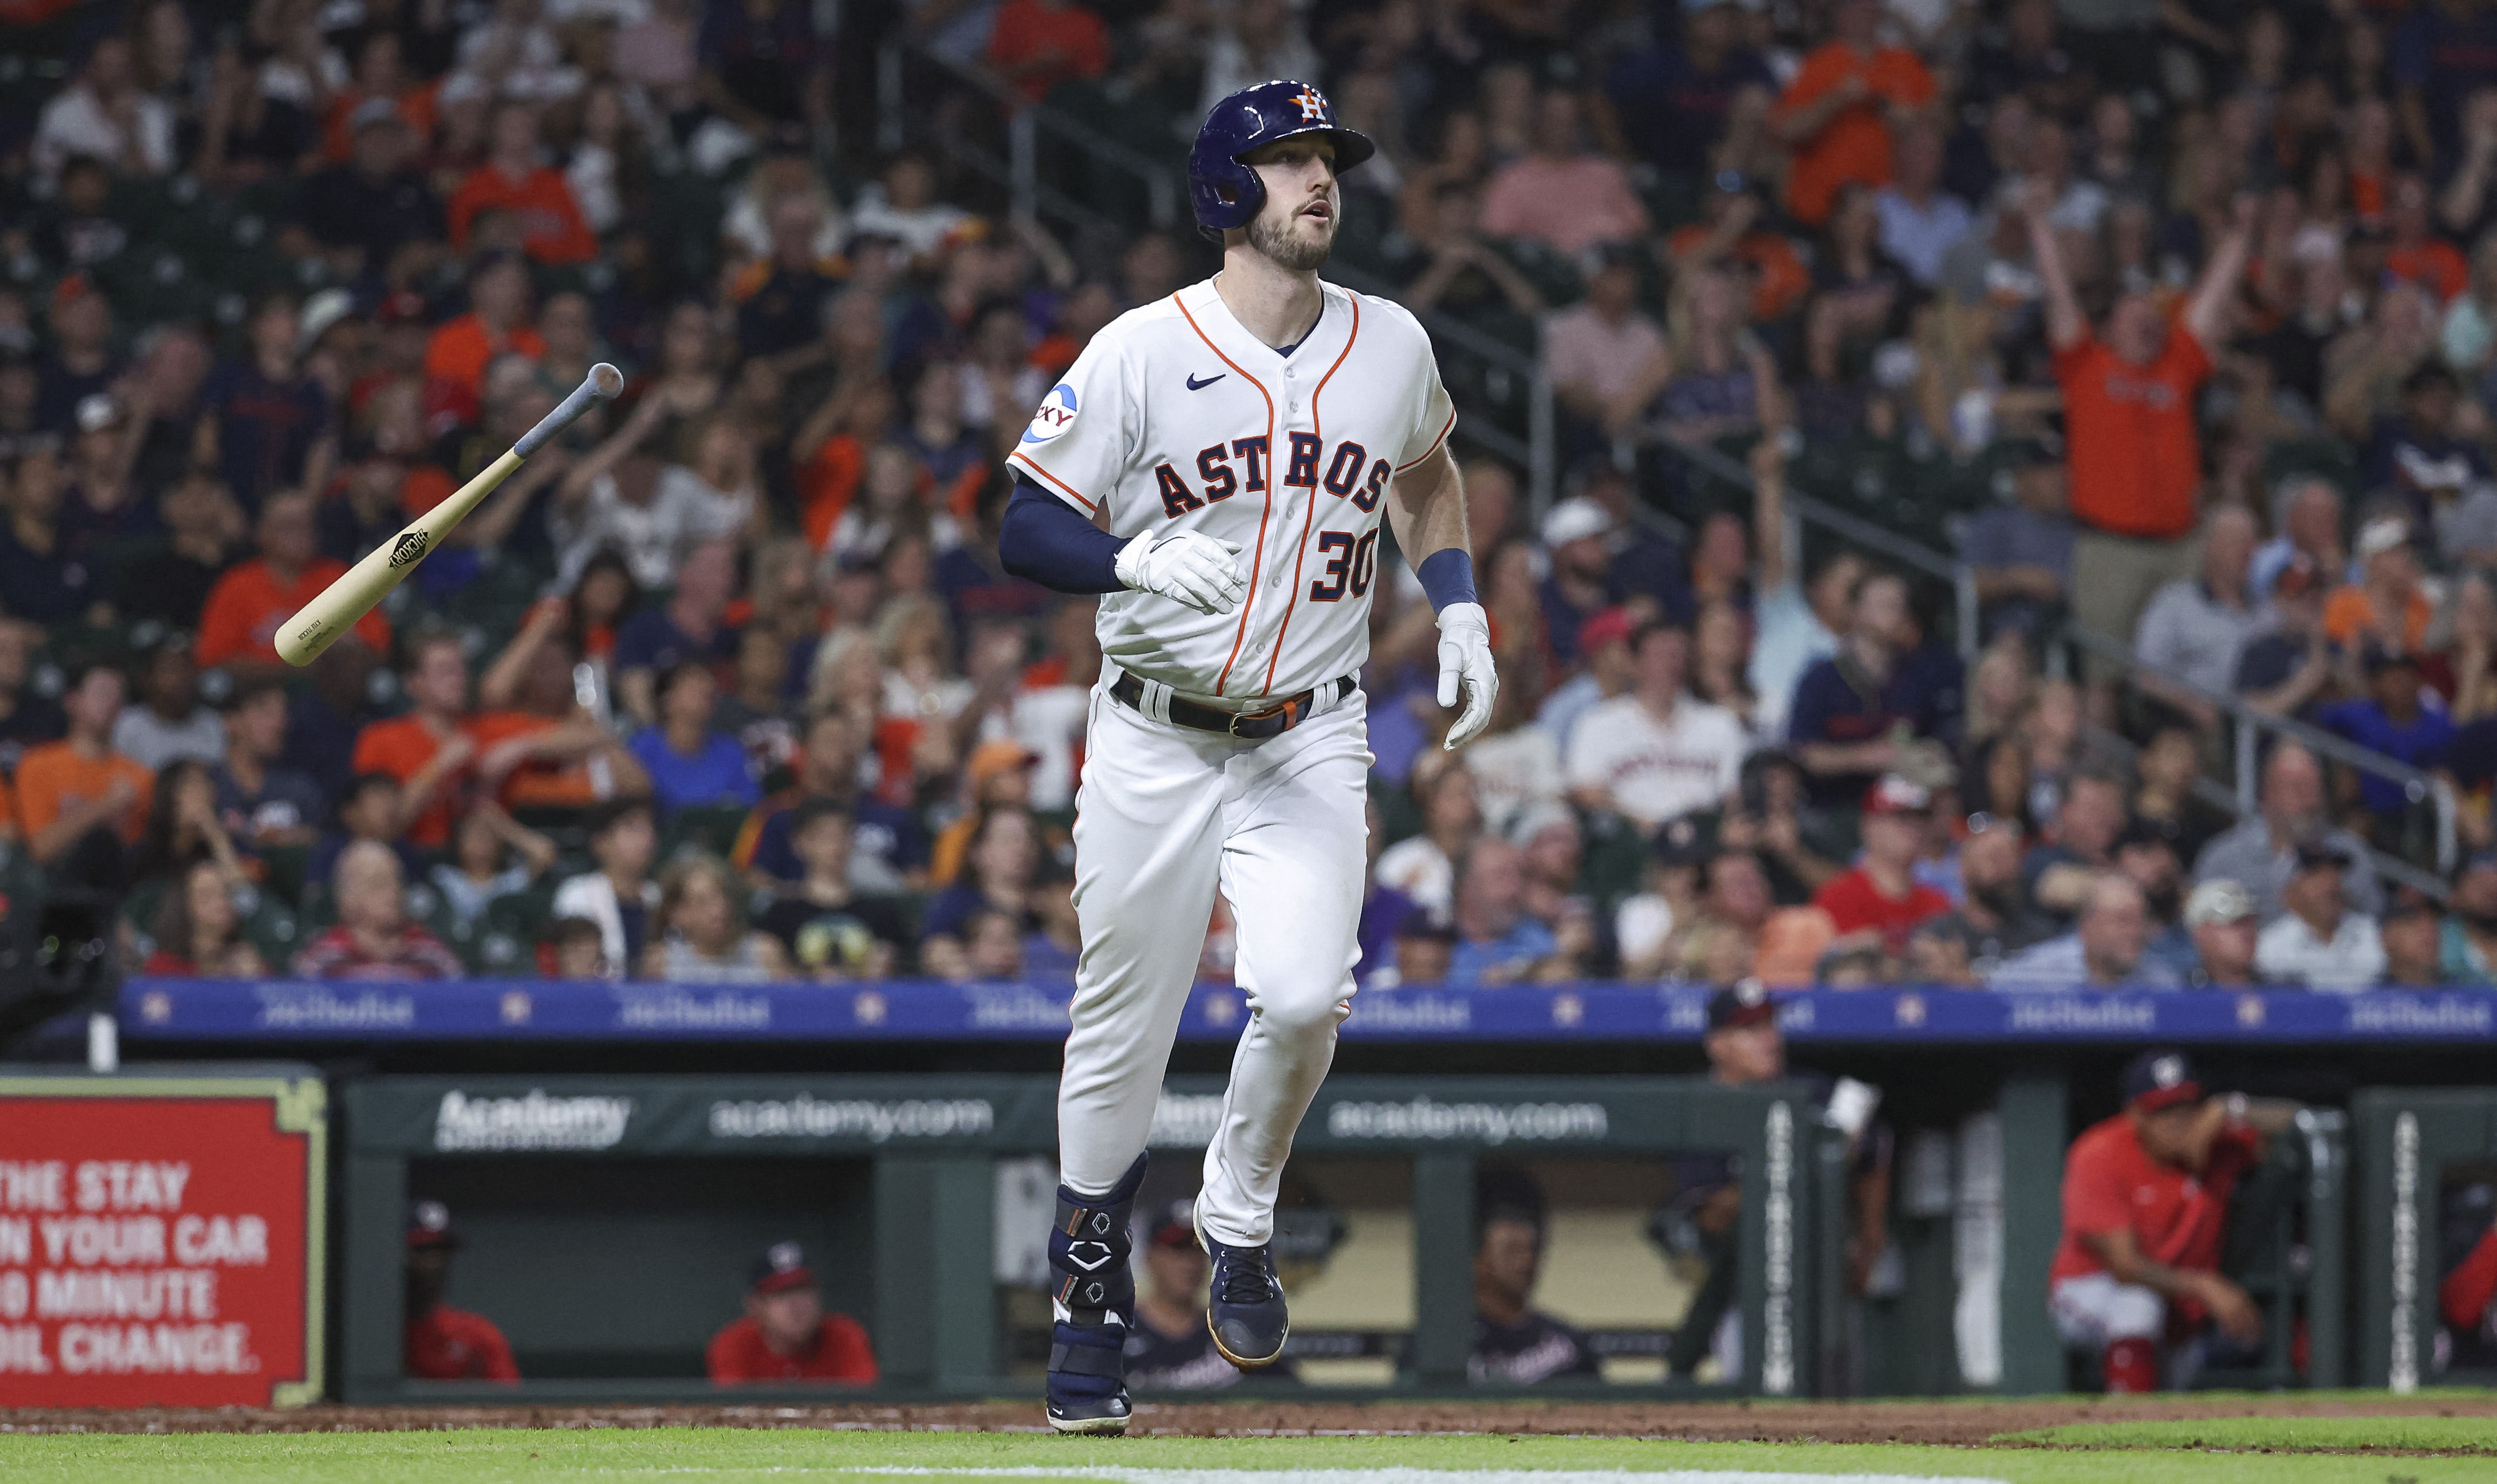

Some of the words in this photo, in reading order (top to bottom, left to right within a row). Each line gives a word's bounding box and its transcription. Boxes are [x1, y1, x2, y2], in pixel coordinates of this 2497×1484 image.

[1296, 95, 1326, 121] H
[1154, 431, 1391, 519] ASTROS
[388, 529, 429, 570] HICKORY
[1309, 528, 1379, 602] 30
[75, 1160, 191, 1210] STAY
[0, 1214, 31, 1266] N
[39, 1214, 166, 1266] YOUR
[173, 1213, 268, 1267] CAR
[36, 1269, 218, 1319] MINUTE
